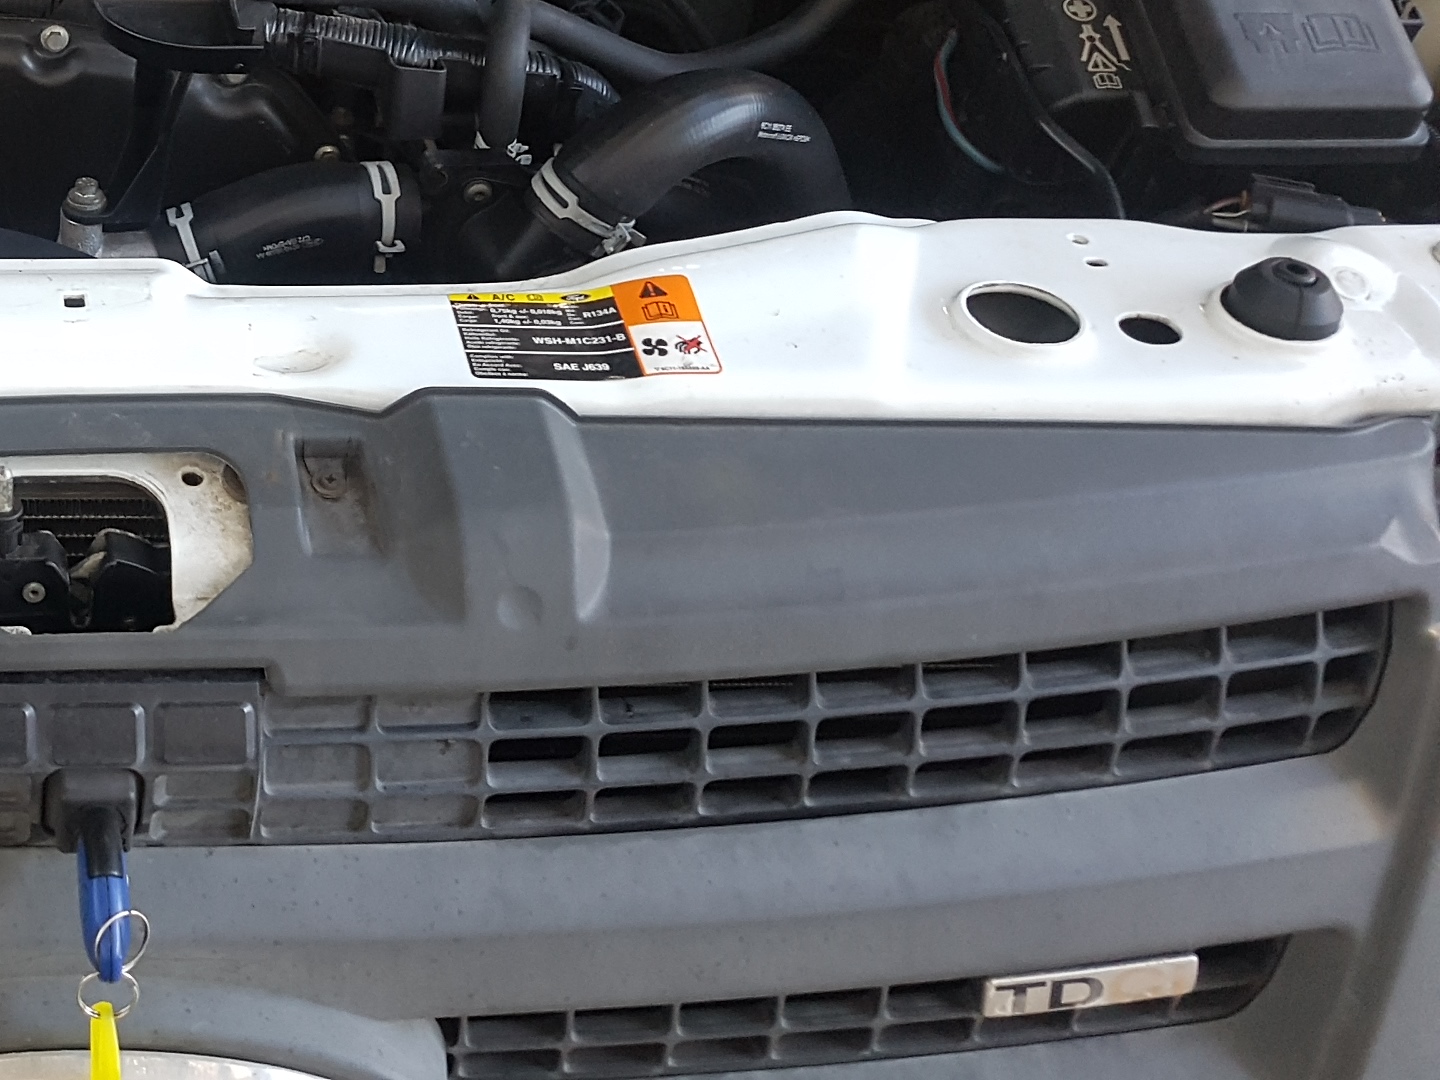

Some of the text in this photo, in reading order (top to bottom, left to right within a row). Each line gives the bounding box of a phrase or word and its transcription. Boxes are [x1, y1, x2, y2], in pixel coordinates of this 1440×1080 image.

[582, 306, 617, 319] R134A
[531, 333, 626, 345] WSH-M1C231-B
[553, 362, 610, 371] SAE J639
